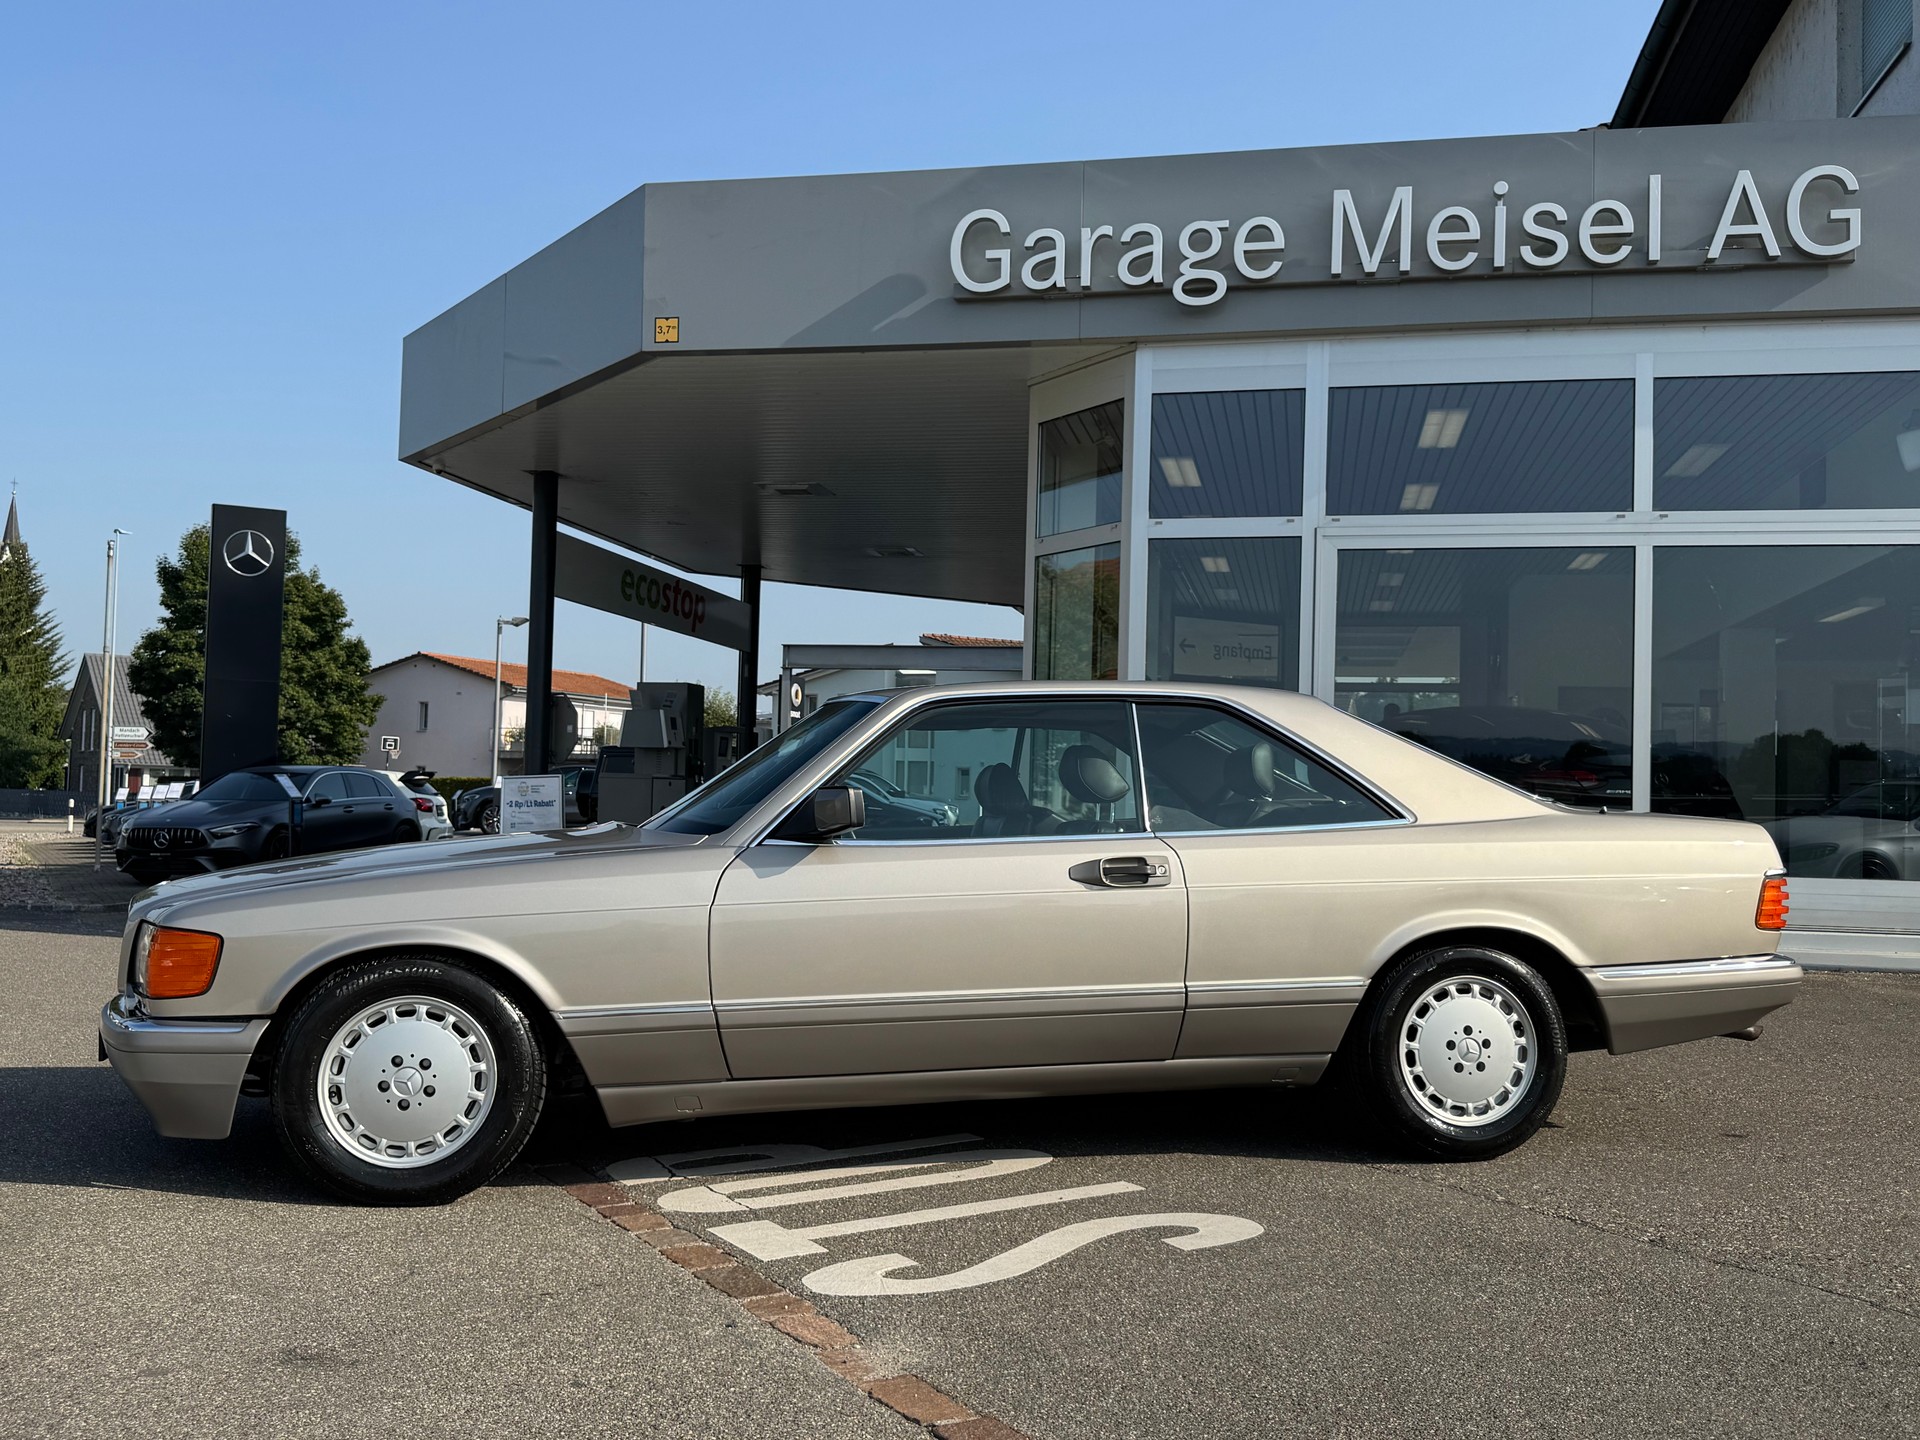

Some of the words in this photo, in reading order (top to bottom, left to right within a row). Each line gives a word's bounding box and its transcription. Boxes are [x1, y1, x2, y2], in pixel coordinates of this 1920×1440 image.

[950, 209, 1286, 306] Garage
[1330, 174, 1662, 277] Meisel
[1704, 164, 1862, 263] AG
[621, 568, 706, 633] ecostop
[606, 1133, 1265, 1297] STOP
